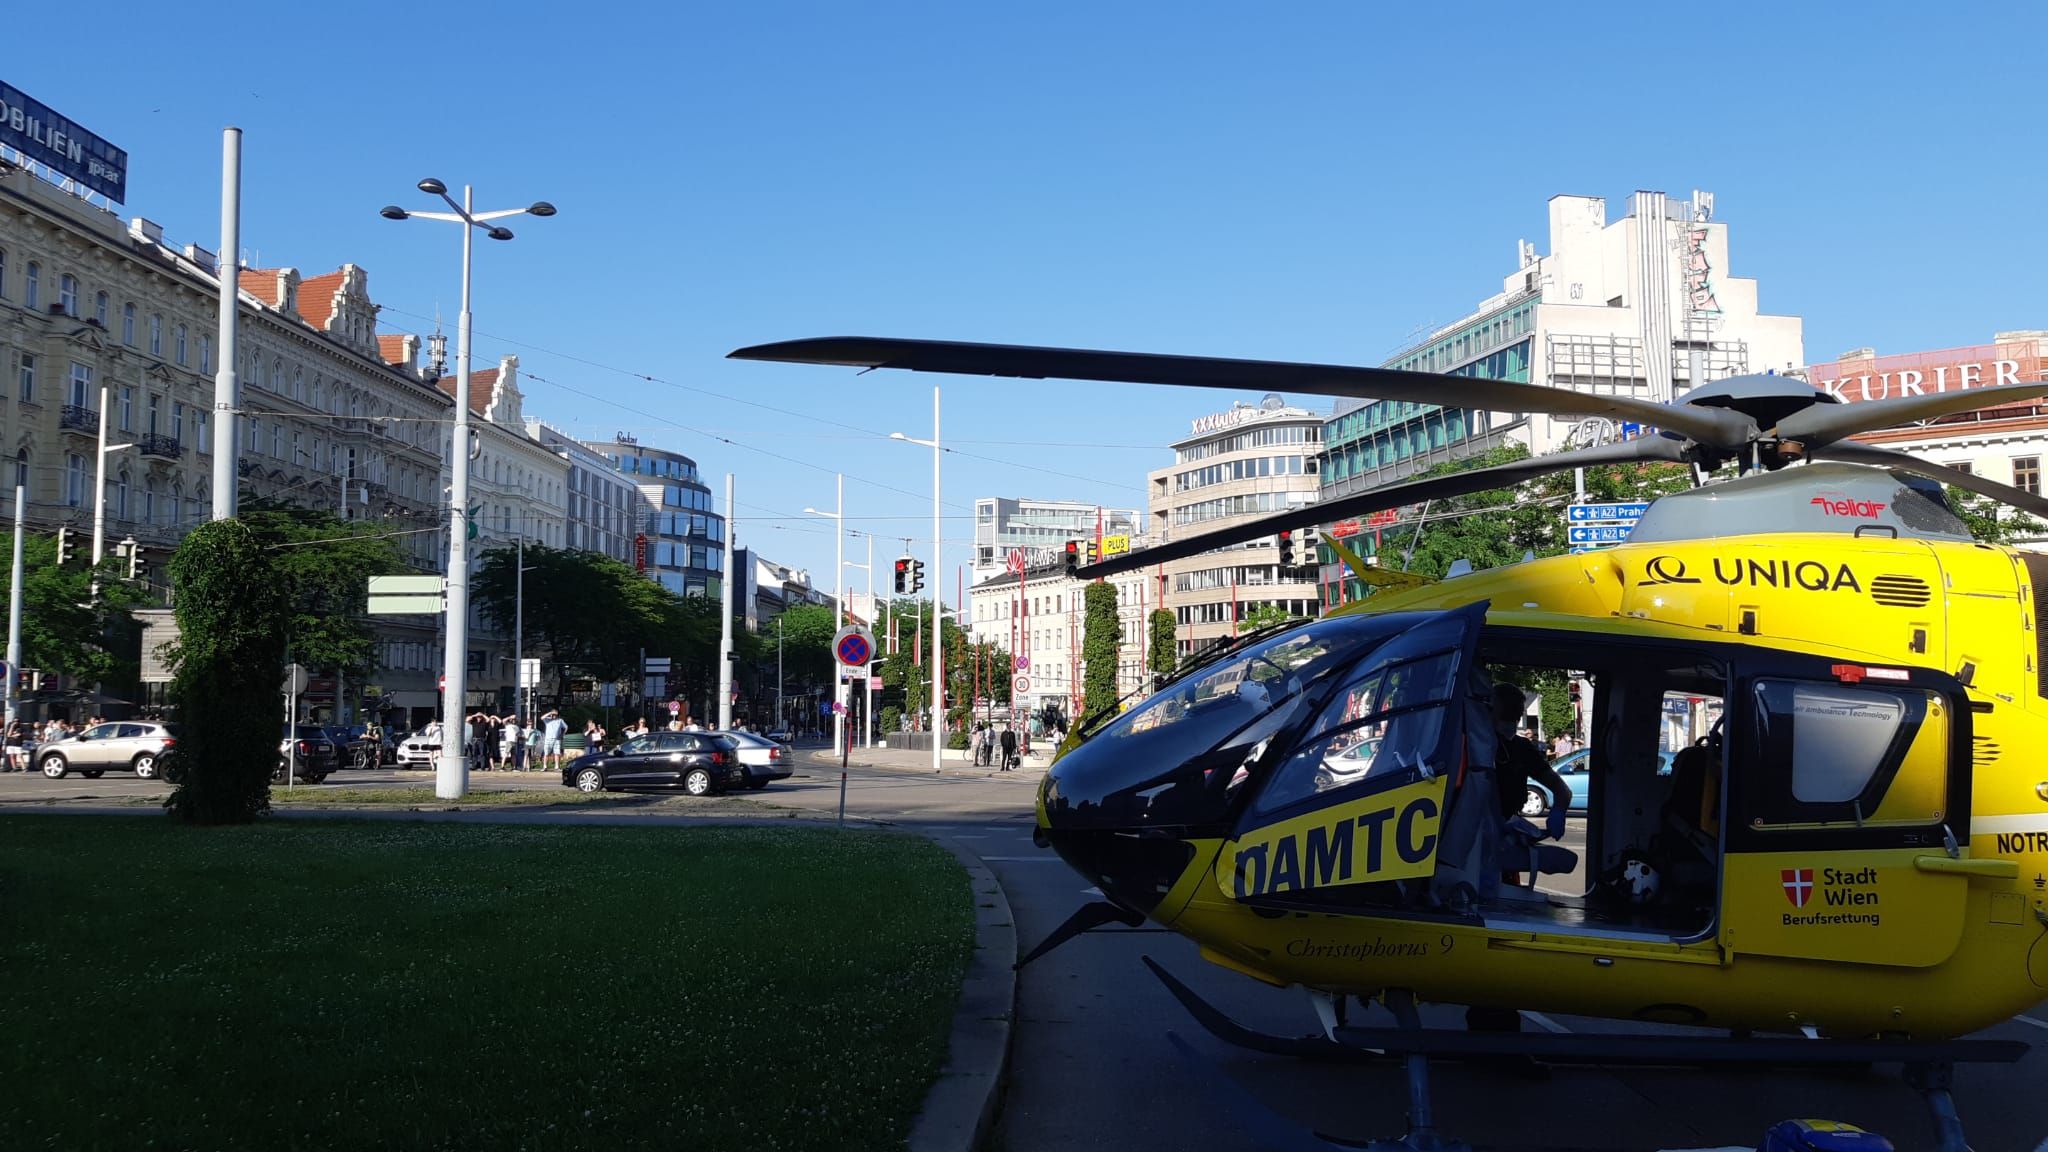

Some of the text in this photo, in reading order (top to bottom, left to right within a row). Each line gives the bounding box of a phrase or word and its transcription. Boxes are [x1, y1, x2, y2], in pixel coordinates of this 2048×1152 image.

[1821, 359, 2022, 404] KURIER
[1602, 508, 1615, 517] A22
[1811, 497, 1886, 519] heliair
[1603, 529, 1616, 538] A22
[1108, 538, 1125, 550] PLUS
[1712, 558, 1862, 593] UNIQA
[1018, 680, 1026, 689] 30
[1015, 693, 1029, 701] Zone
[1805, 706, 1847, 715] ambulance
[1847, 704, 1892, 720] Technology
[1997, 832, 2048, 854] NOTR
[1823, 867, 1878, 886] Stadt
[1824, 888, 1879, 906] Wien
[1782, 912, 1880, 926] Berufsrettung
[1286, 934, 1455, 961] Christophorus 9
